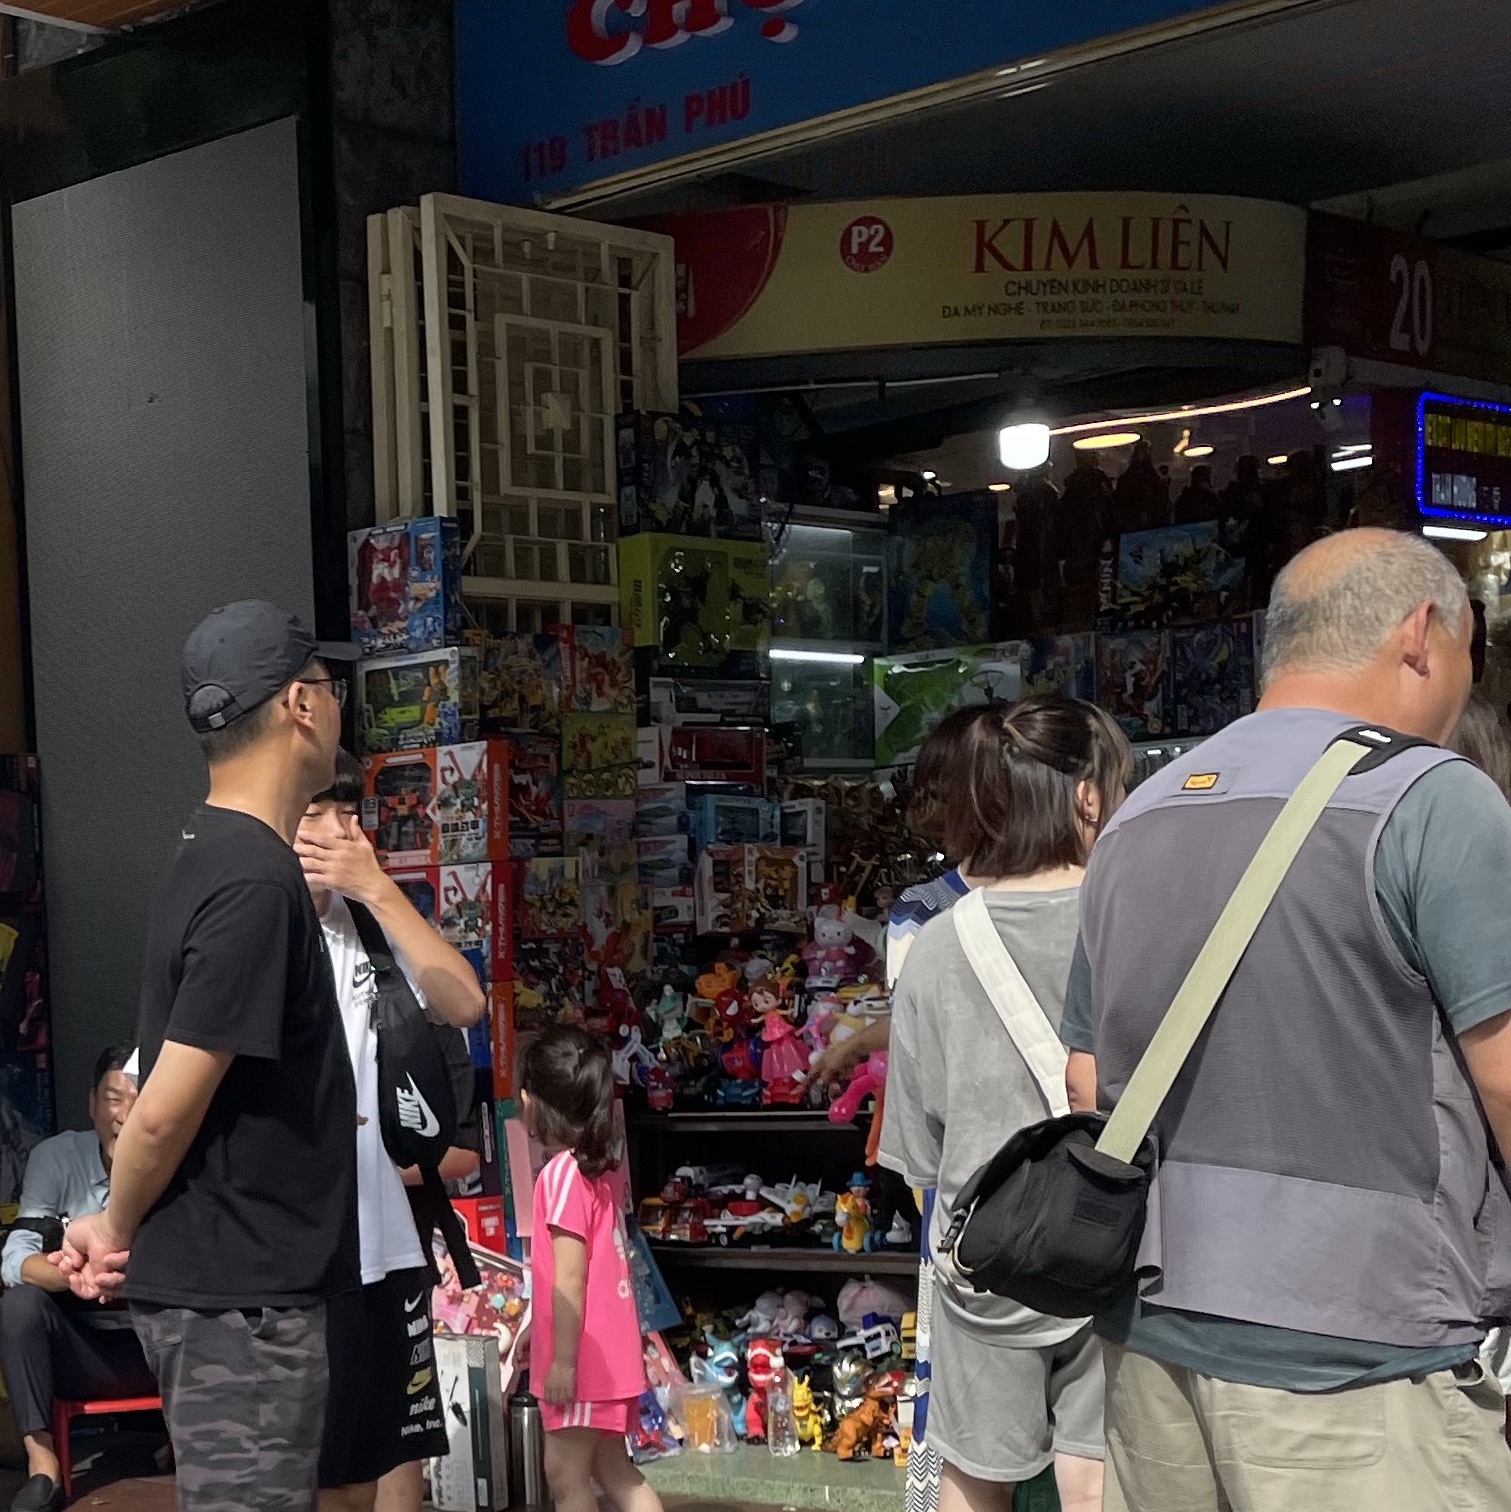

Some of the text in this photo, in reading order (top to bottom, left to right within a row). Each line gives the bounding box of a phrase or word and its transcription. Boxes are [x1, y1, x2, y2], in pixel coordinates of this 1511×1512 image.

[519, 135, 568, 181] 119
[851, 224, 885, 254] P2
[971, 204, 1234, 274] KIM LIÊN
[1389, 253, 1432, 357] 20
[395, 1086, 424, 1130] NIKE
